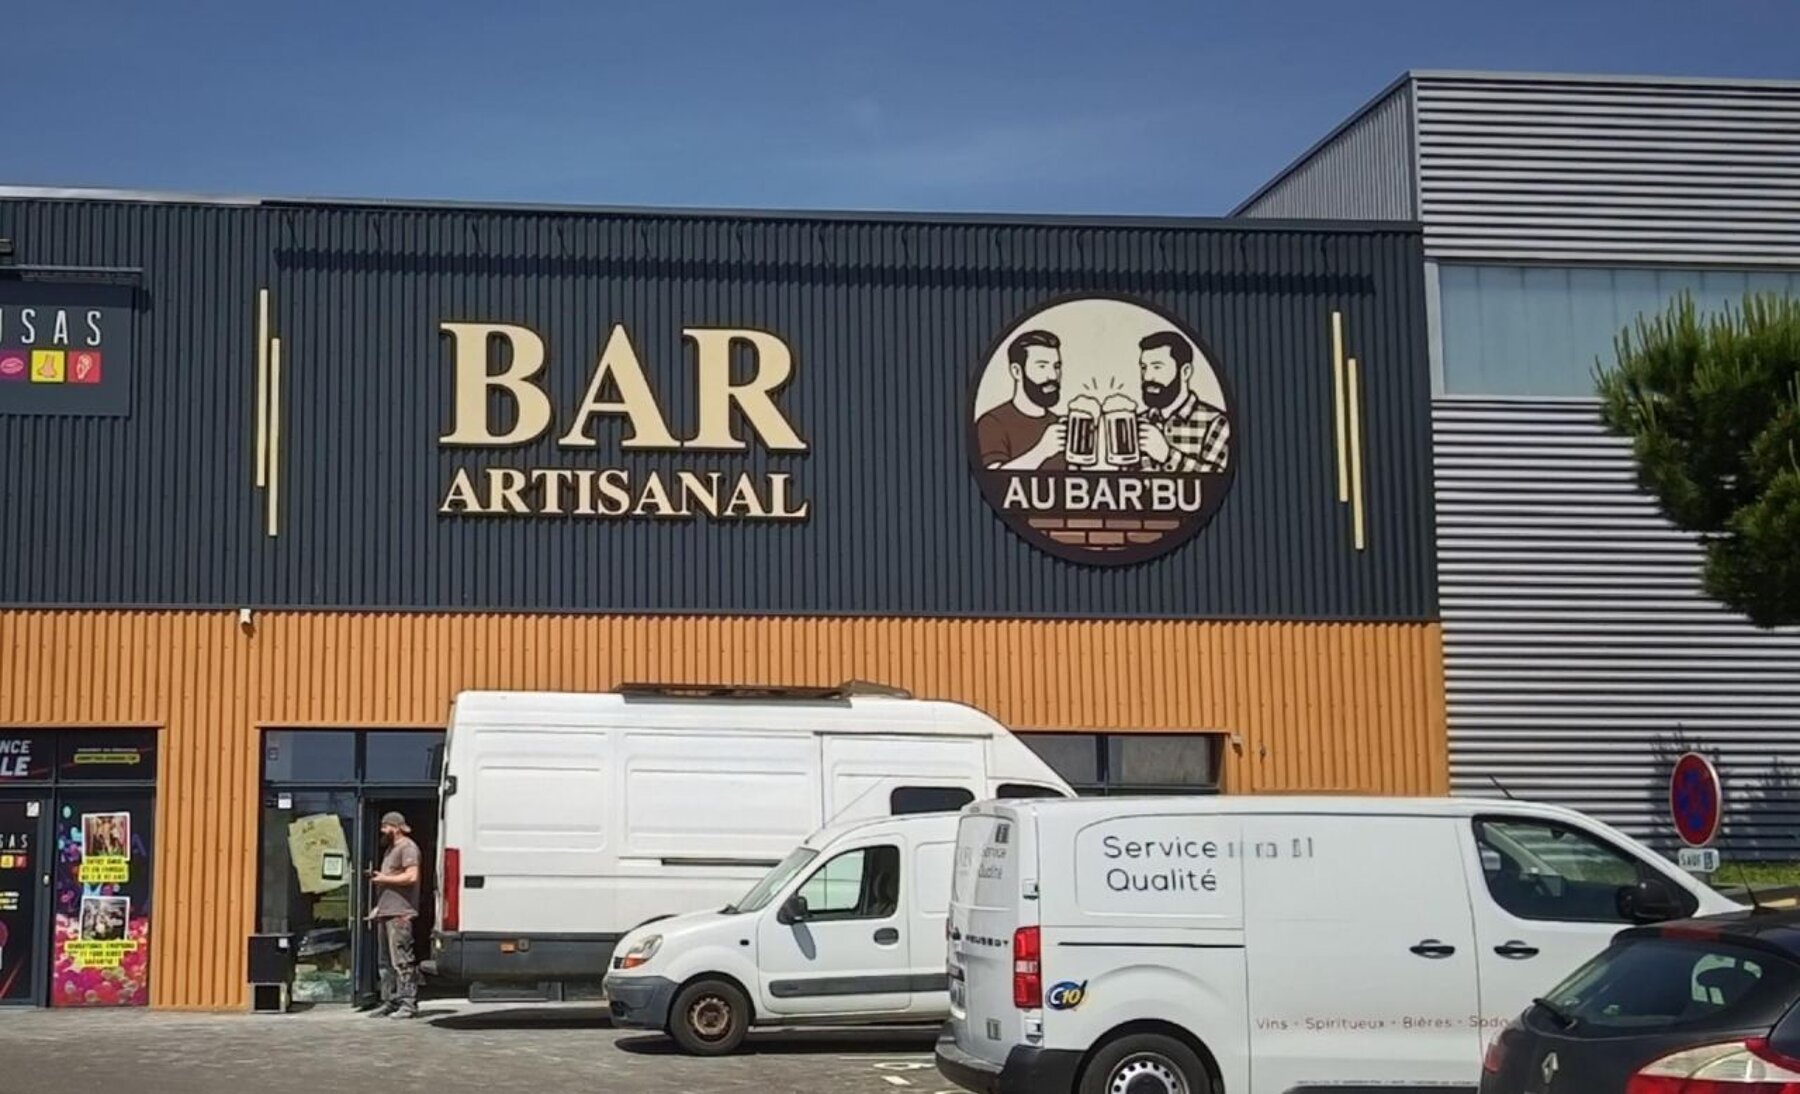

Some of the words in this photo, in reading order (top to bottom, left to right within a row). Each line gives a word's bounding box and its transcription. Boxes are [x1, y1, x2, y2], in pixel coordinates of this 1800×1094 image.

[0, 307, 101, 347] SAS
[439, 322, 808, 450] BAR
[439, 466, 808, 519] ARTISANAL
[1003, 476, 1055, 510] AU
[1064, 477, 1202, 513] BAR'BU
[1102, 835, 1218, 859] Service
[1106, 868, 1217, 892] Qualité
[1256, 1018, 1288, 1030] Vins
[1304, 1017, 1385, 1031] Spiritueux
[1403, 1016, 1452, 1029] Bières
